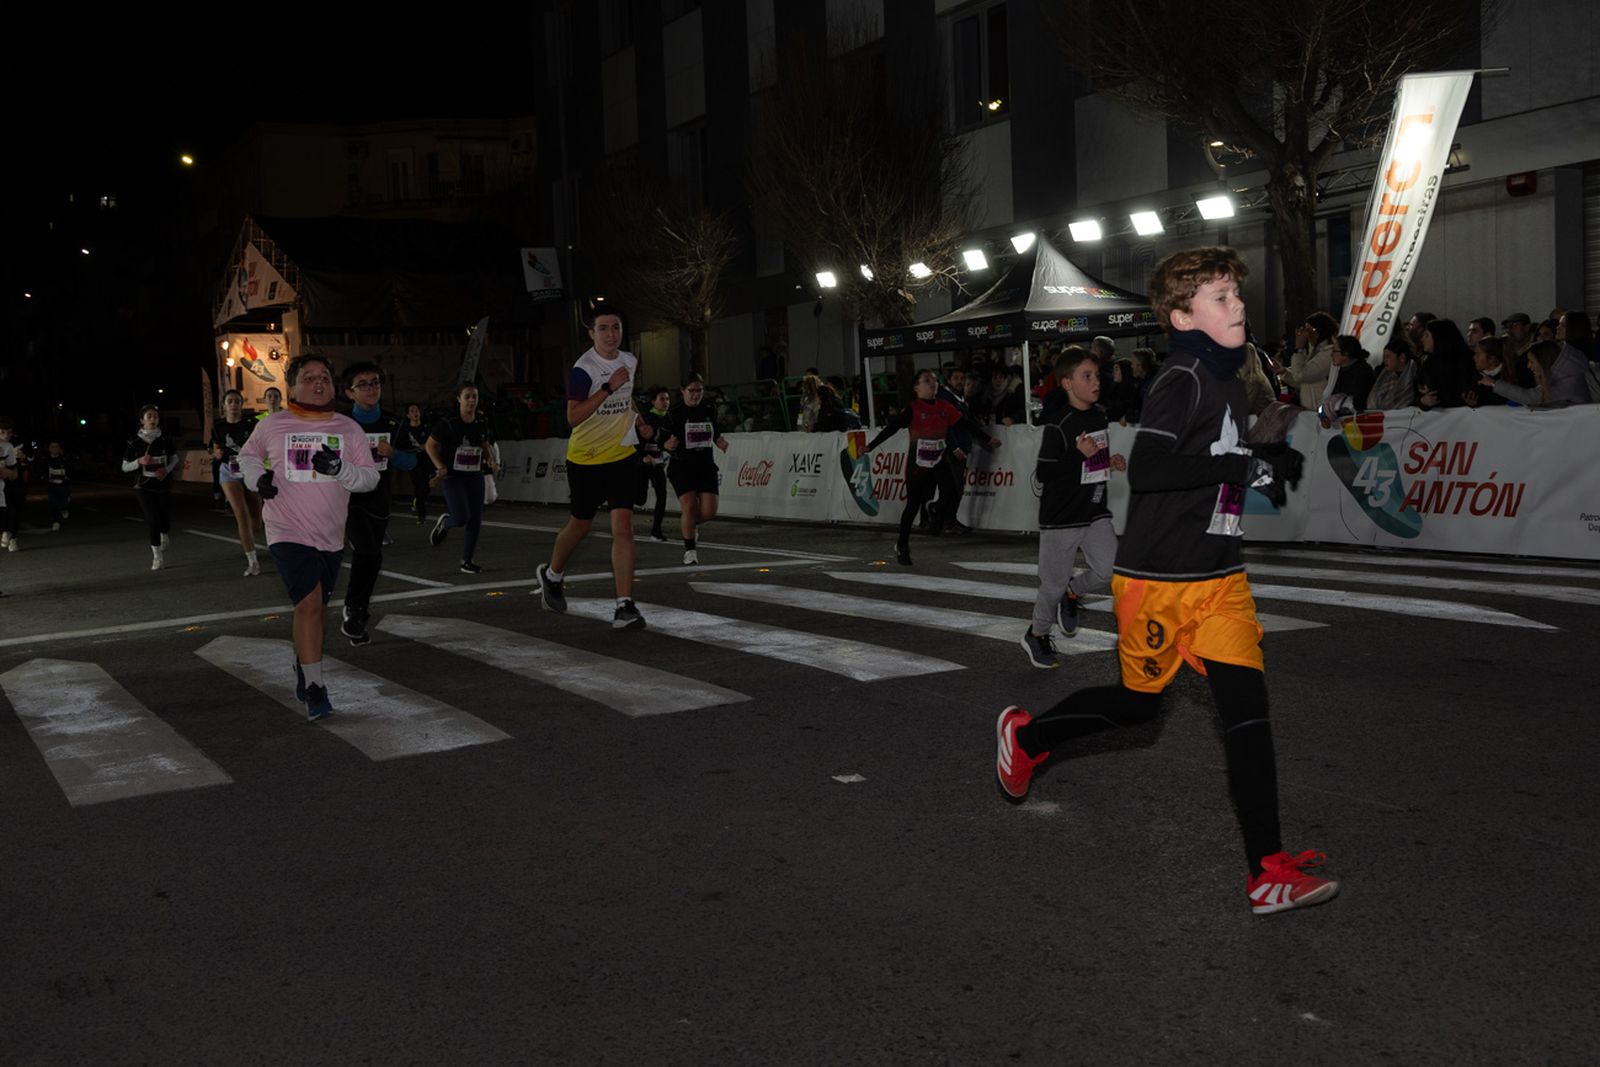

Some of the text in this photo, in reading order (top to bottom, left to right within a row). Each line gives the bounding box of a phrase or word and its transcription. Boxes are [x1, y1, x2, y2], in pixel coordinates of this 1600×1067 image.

[1376, 278, 1404, 336] obras
[788, 453, 823, 474] XAVE
[872, 453, 905, 475] SAN
[1403, 441, 1479, 476] SAN
[850, 463, 869, 497] 43
[962, 467, 1014, 487] lderón
[1352, 456, 1397, 508] 43
[1398, 472, 1526, 517] ANTÓN
[1147, 619, 1164, 650] 9
